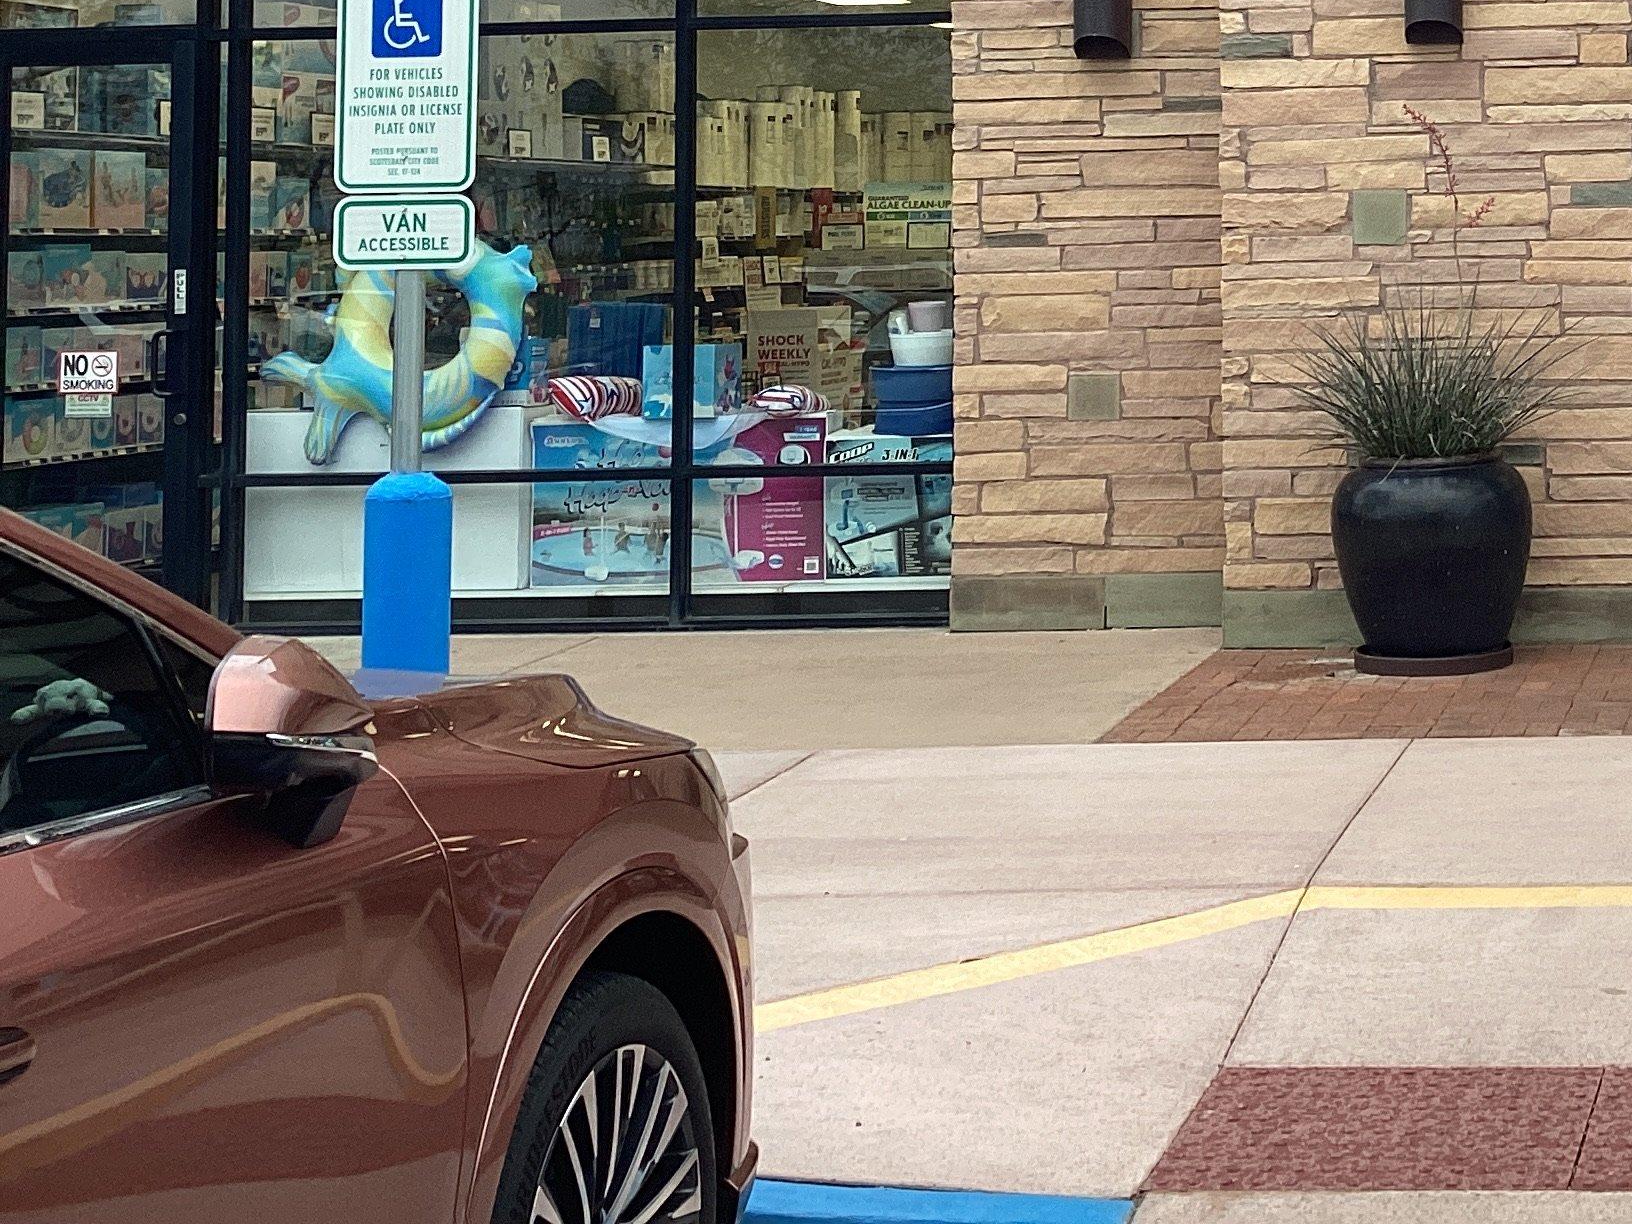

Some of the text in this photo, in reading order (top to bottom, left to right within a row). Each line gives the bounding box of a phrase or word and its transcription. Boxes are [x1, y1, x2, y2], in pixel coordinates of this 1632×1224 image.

[369, 67, 443, 81] FOR VEHICLES
[353, 85, 459, 99] SHOWING DISABLED
[349, 103, 463, 117] INSIGNIA OR LICENSE
[374, 121, 436, 135] PLATE ONLY
[866, 199, 952, 210] ALGAE CLEAN-UP
[382, 213, 427, 233] VAN
[357, 236, 449, 252] ACCESSIBLE
[757, 335, 804, 346] SHOCK
[757, 348, 811, 360] WEEKLY
[63, 354, 89, 377] NO
[62, 379, 114, 391] SMOKING
[77, 394, 100, 402] CCTV
